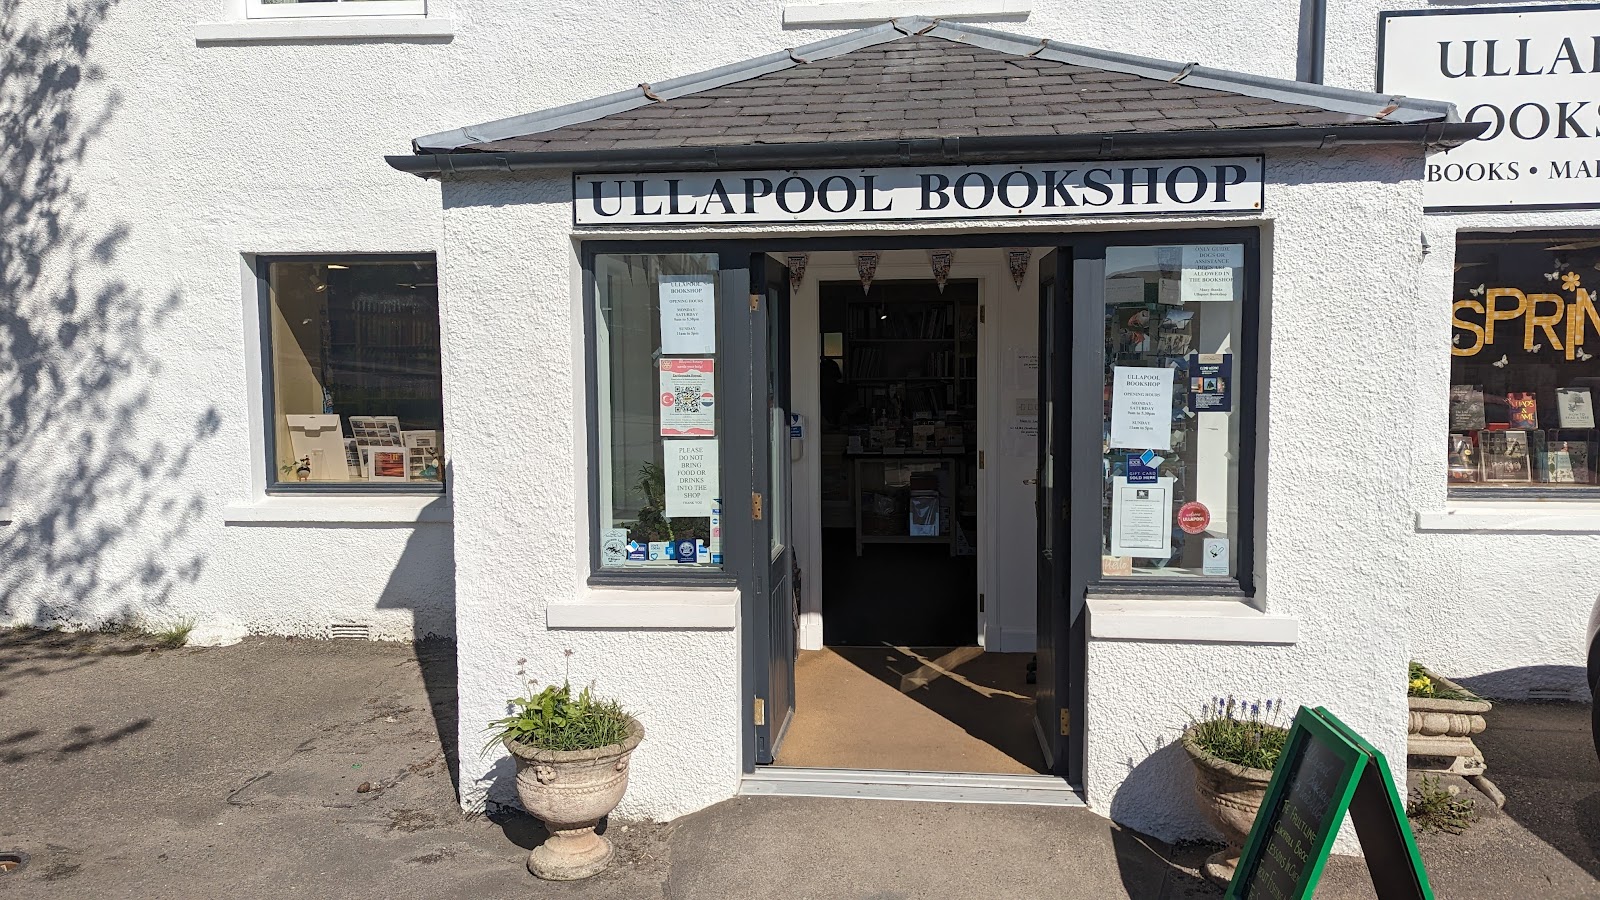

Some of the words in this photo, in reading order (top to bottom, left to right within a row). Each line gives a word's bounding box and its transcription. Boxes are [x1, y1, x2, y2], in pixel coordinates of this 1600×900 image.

[1464, 101, 1600, 142] OOK
[1427, 161, 1520, 182] BOOKS
[589, 174, 893, 218] ULLAPOOL
[915, 163, 1248, 211] BOOKSHOP
[1294, 840, 1308, 862] BROC
